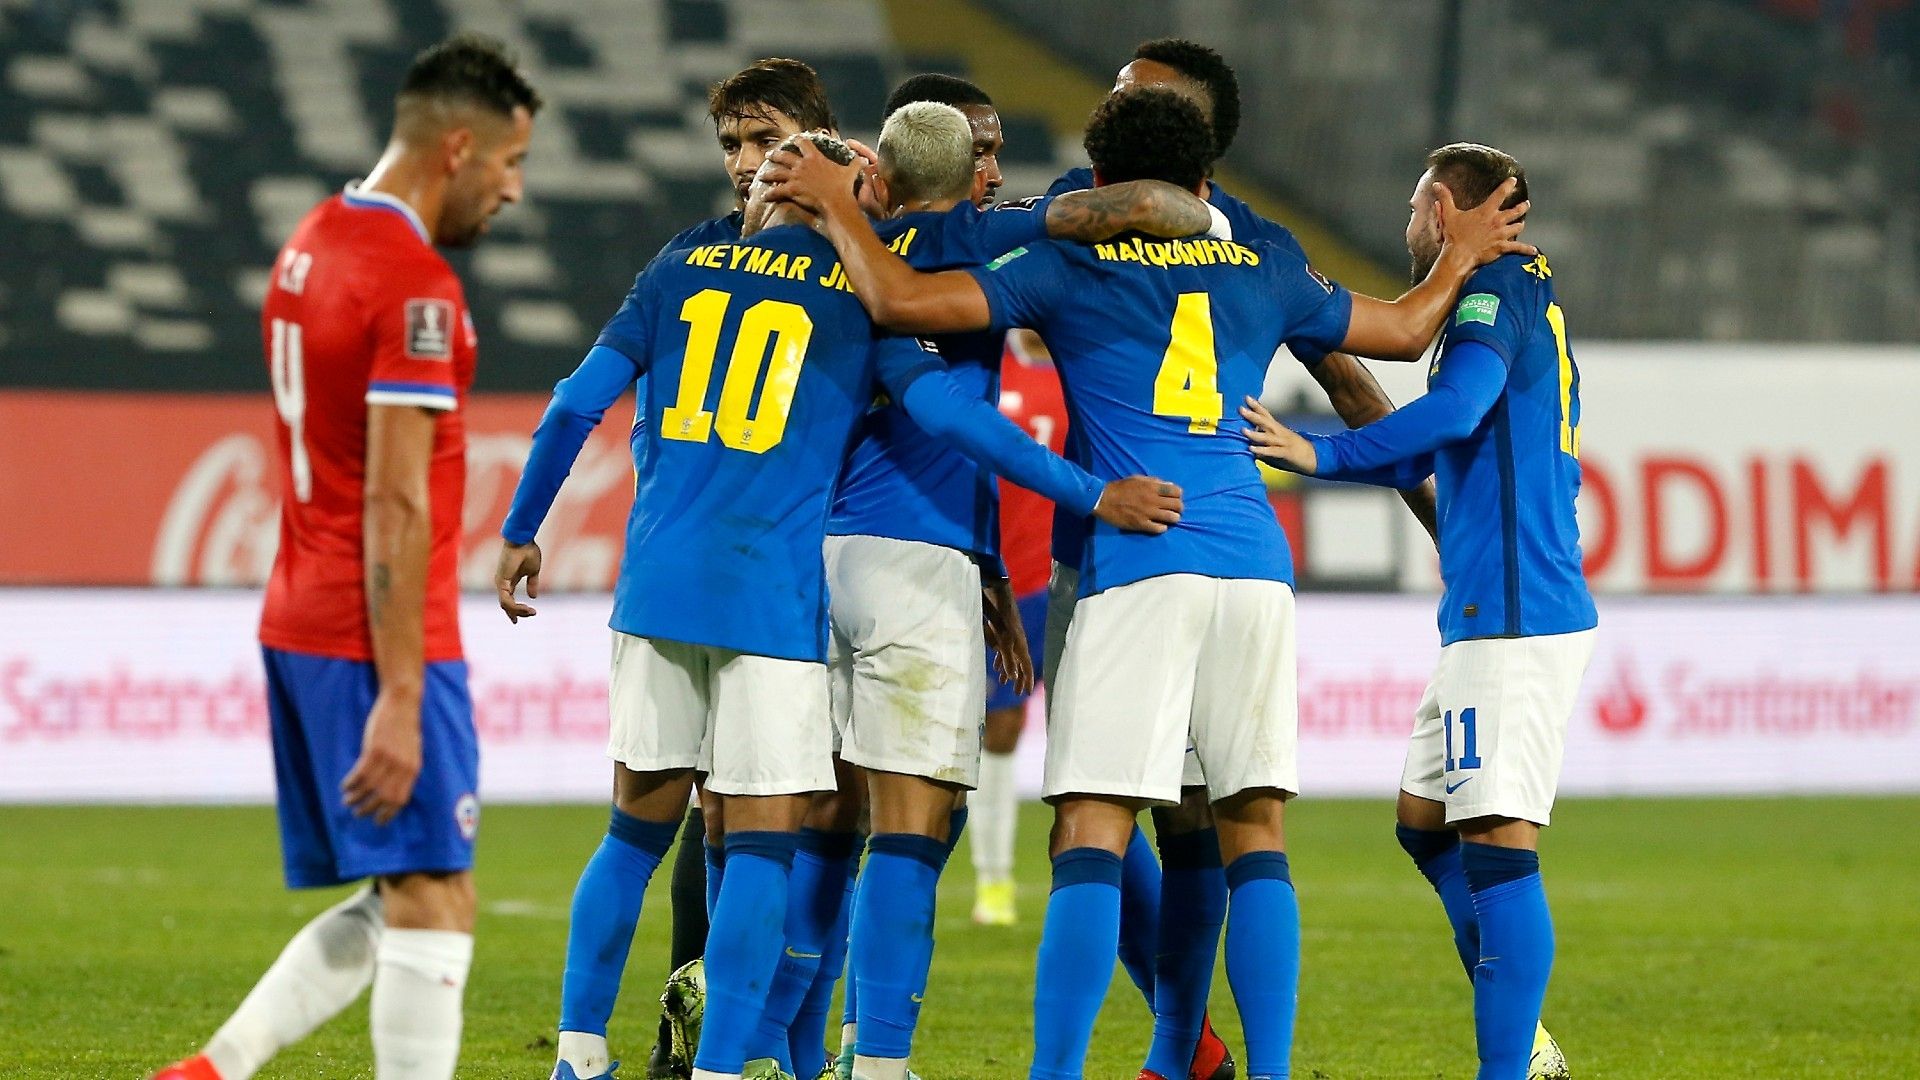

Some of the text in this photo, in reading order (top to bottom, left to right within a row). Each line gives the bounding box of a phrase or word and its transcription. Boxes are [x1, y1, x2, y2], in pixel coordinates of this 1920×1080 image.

[686, 243, 811, 281] NEYMAR
[662, 289, 812, 454] 10
[1153, 292, 1222, 435] 4
[1444, 707, 1482, 772] 11
